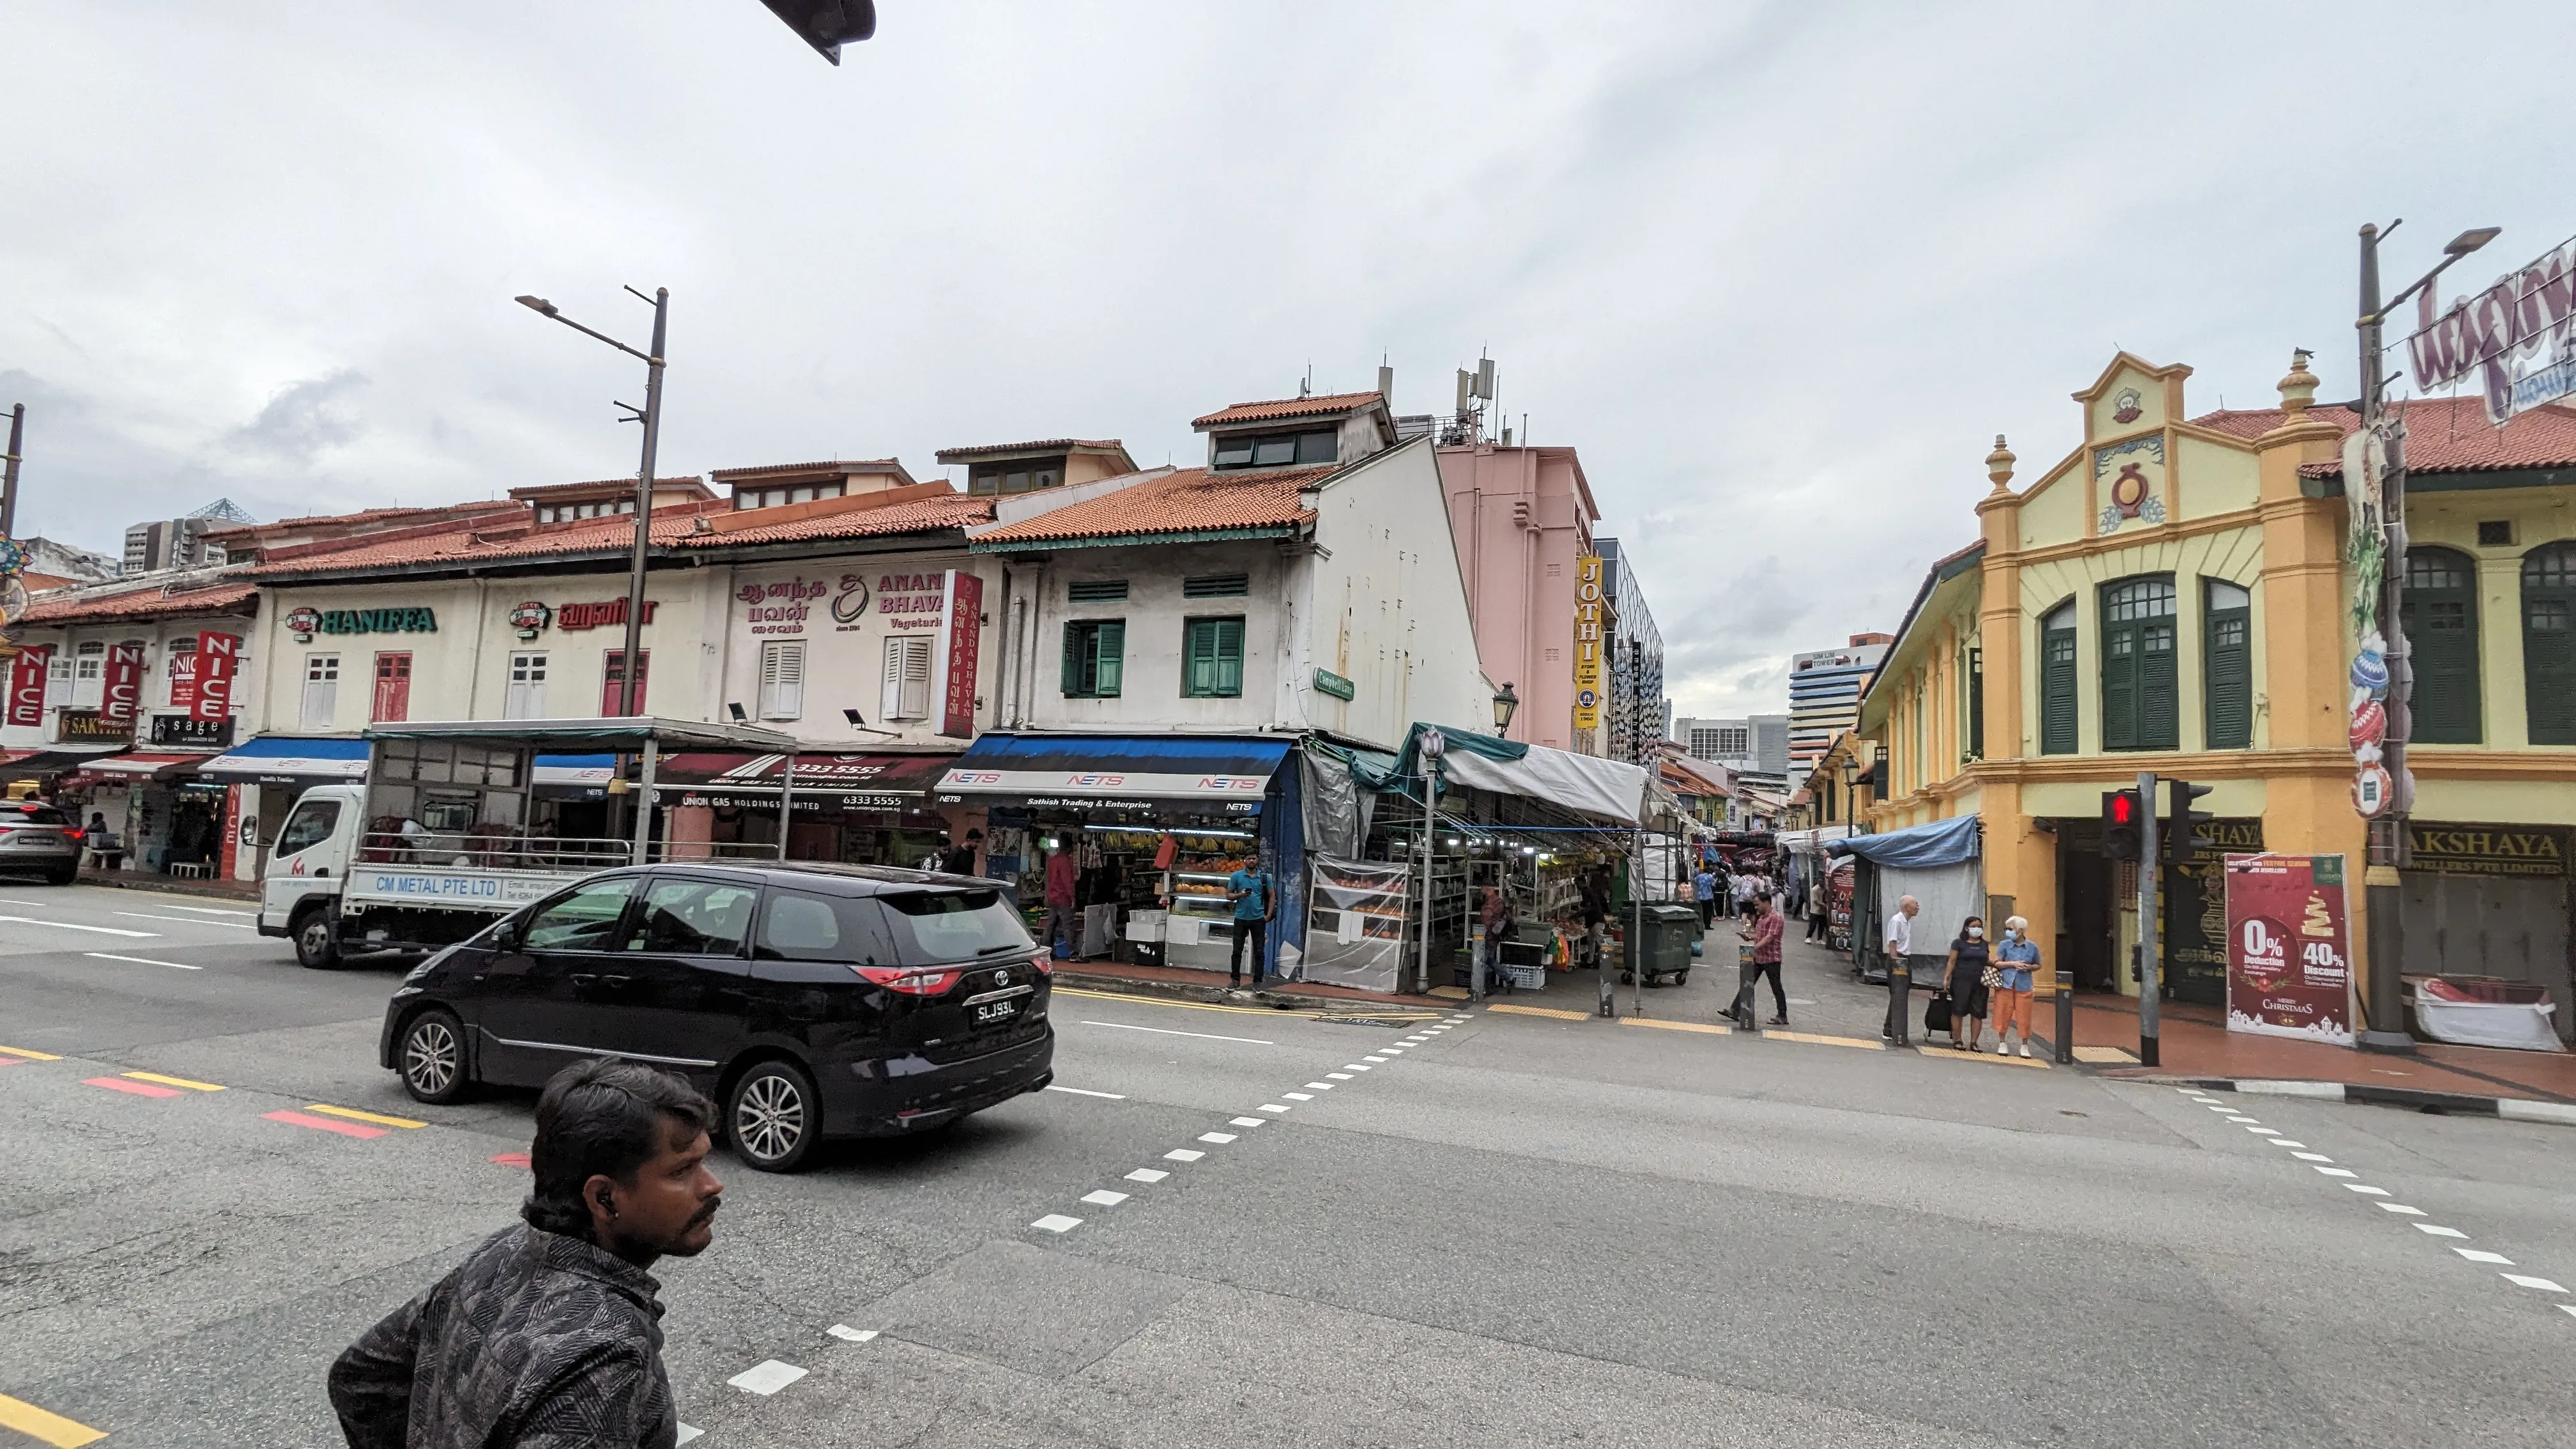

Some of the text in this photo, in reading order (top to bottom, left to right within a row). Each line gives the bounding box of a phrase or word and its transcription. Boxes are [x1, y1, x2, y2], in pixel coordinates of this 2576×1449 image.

[736, 576, 827, 604] ஆனந்த
[877, 574, 946, 592] ANAN
[748, 602, 810, 622] பவன்
[879, 595, 944, 613] BHAVA
[1579, 564, 1600, 661] JOTHI
[323, 608, 438, 634] HANIFFA
[891, 617, 943, 629] Vegetaria
[968, 602, 977, 657] ANANDA
[176, 656, 197, 673] NIC
[15, 650, 45, 721] NICE
[109, 647, 138, 718] NICE
[201, 636, 231, 717] NICE
[1319, 671, 1353, 695] Campbell Lane
[963, 661, 973, 716] BHAVAN
[173, 720, 218, 735] sage
[784, 764, 885, 774] 333 5555
[946, 772, 1001, 783] NETS
[1067, 775, 1124, 786] NETS
[1197, 778, 1259, 789] NETS
[683, 797, 819, 810] UNION GAS HOLDINGS IMITED
[843, 796, 901, 806] 6333 5555
[1061, 799, 1094, 808] Trading
[1105, 801, 1151, 809] Enterprise
[1226, 802, 1252, 811] NETS
[226, 784, 240, 844] NICE
[2148, 871, 2154, 880] 2
[376, 877, 495, 896] CM METAL PTE LTD
[2244, 920, 2283, 956] 0%
[2244, 955, 2285, 967] Deduction
[2303, 943, 2344, 967] 40%
[2304, 965, 2345, 977] Discount
[978, 1000, 1015, 1020] SLJ93L
[2263, 999, 2313, 1014] CHRISTMAS
